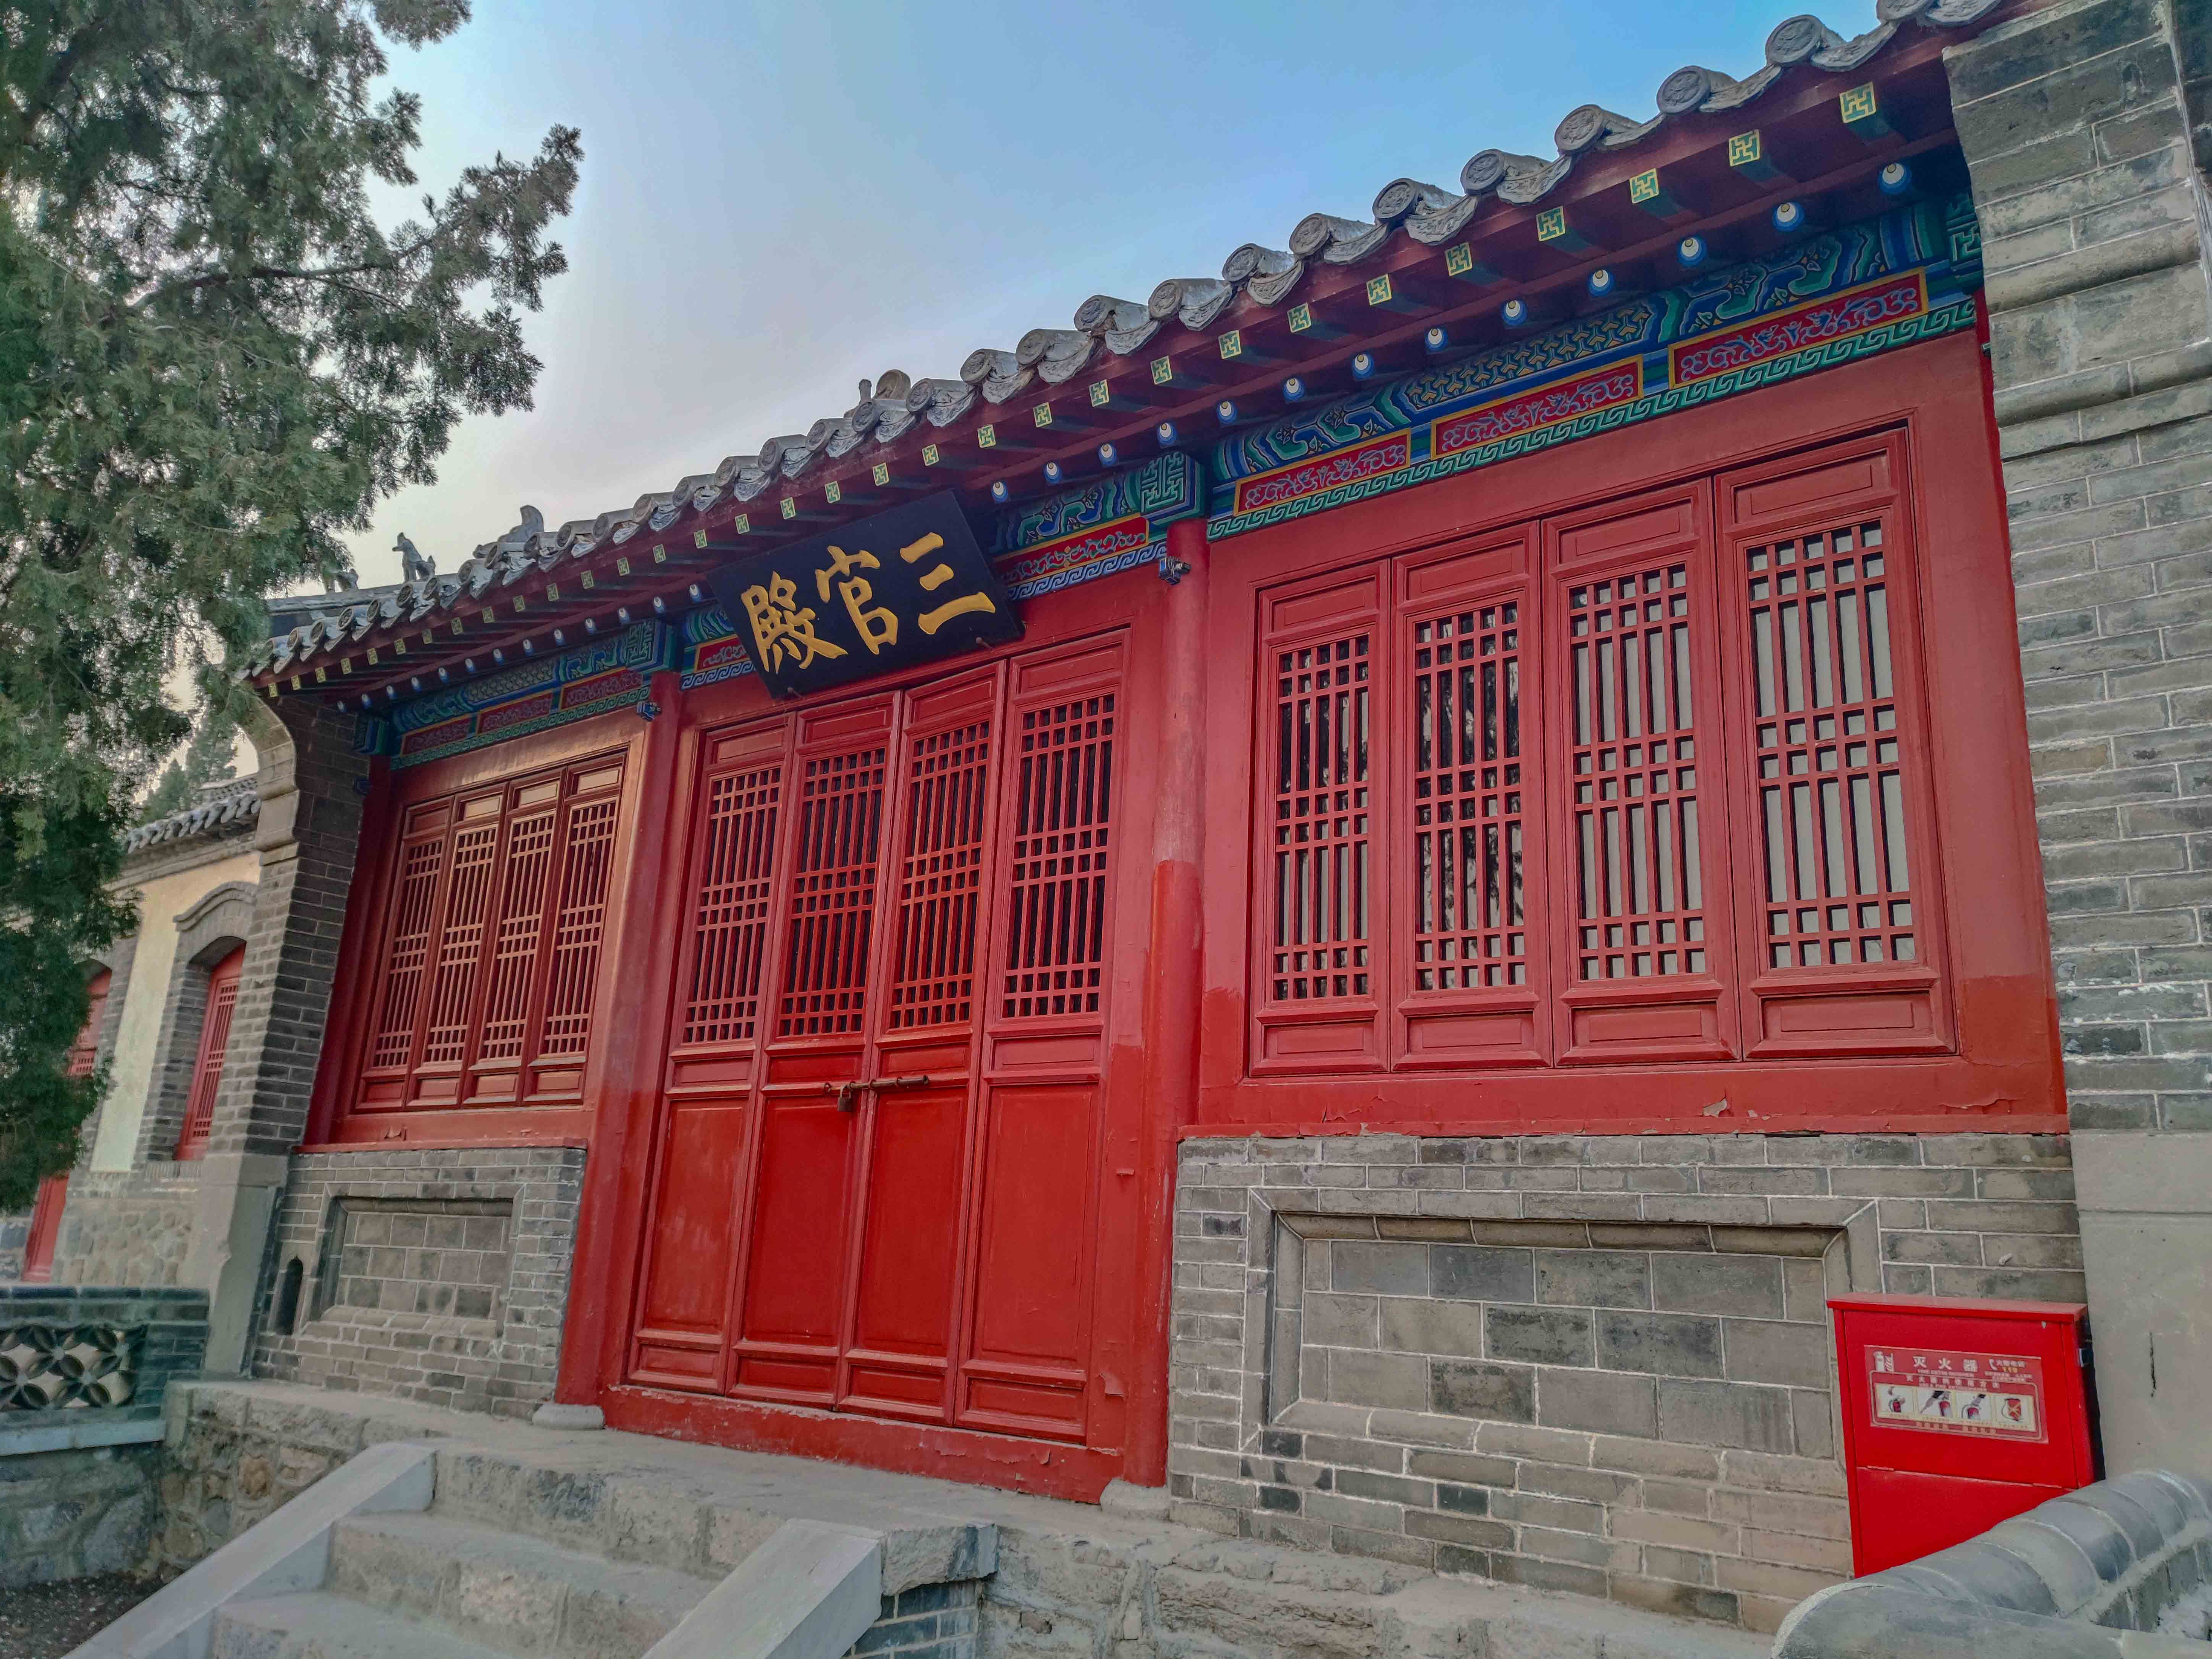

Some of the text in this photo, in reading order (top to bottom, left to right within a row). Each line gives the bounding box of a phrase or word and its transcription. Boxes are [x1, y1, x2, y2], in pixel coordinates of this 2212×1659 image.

[741, 532, 996, 674] 三官殿
[1912, 1356, 1978, 1373] 灭火器
